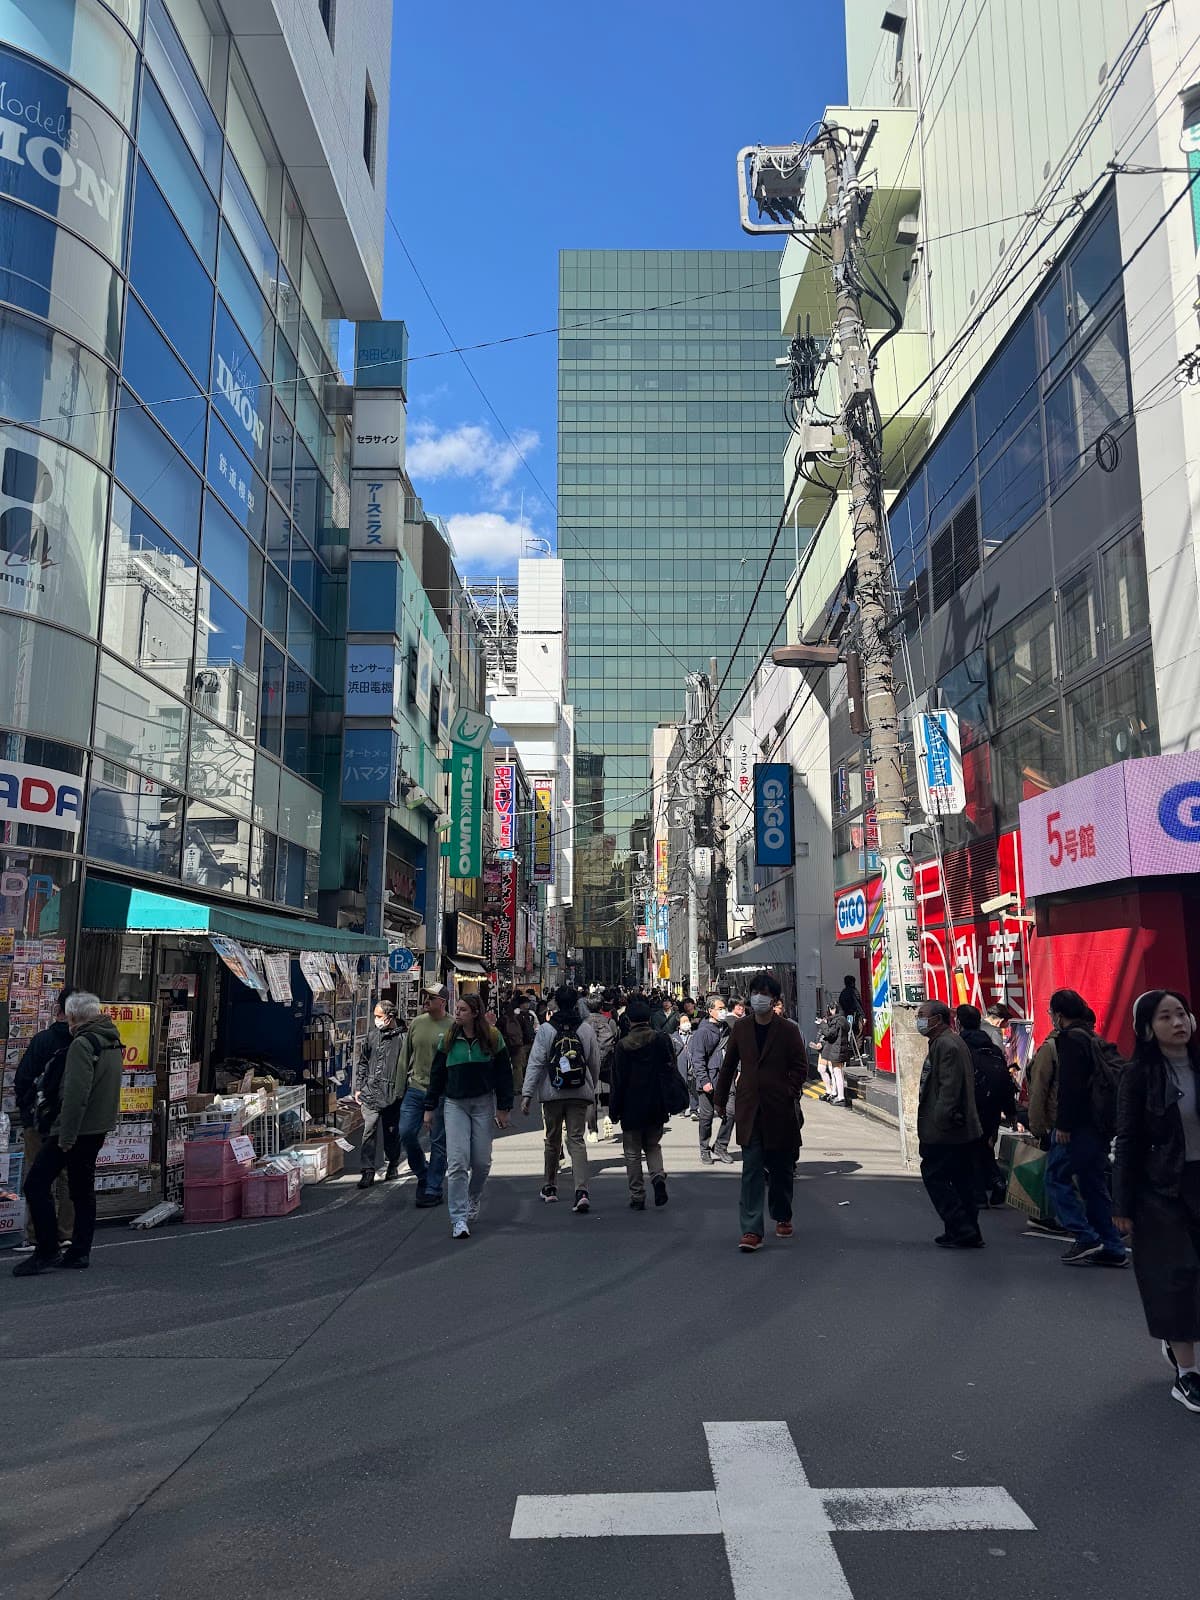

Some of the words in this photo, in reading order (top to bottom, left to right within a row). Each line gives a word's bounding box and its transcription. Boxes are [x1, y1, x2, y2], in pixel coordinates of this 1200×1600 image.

[216, 352, 265, 451] IMON
[356, 434, 398, 445] セラサイン
[366, 483, 384, 545] アースニクス
[347, 681, 393, 694] 浜田電機
[458, 753, 474, 876] TSUKUMO
[1046, 810, 1097, 868] 5号館
[839, 894, 865, 929] GiGO
[902, 885, 921, 962] 福山歯科
[394, 954, 404, 970] P
